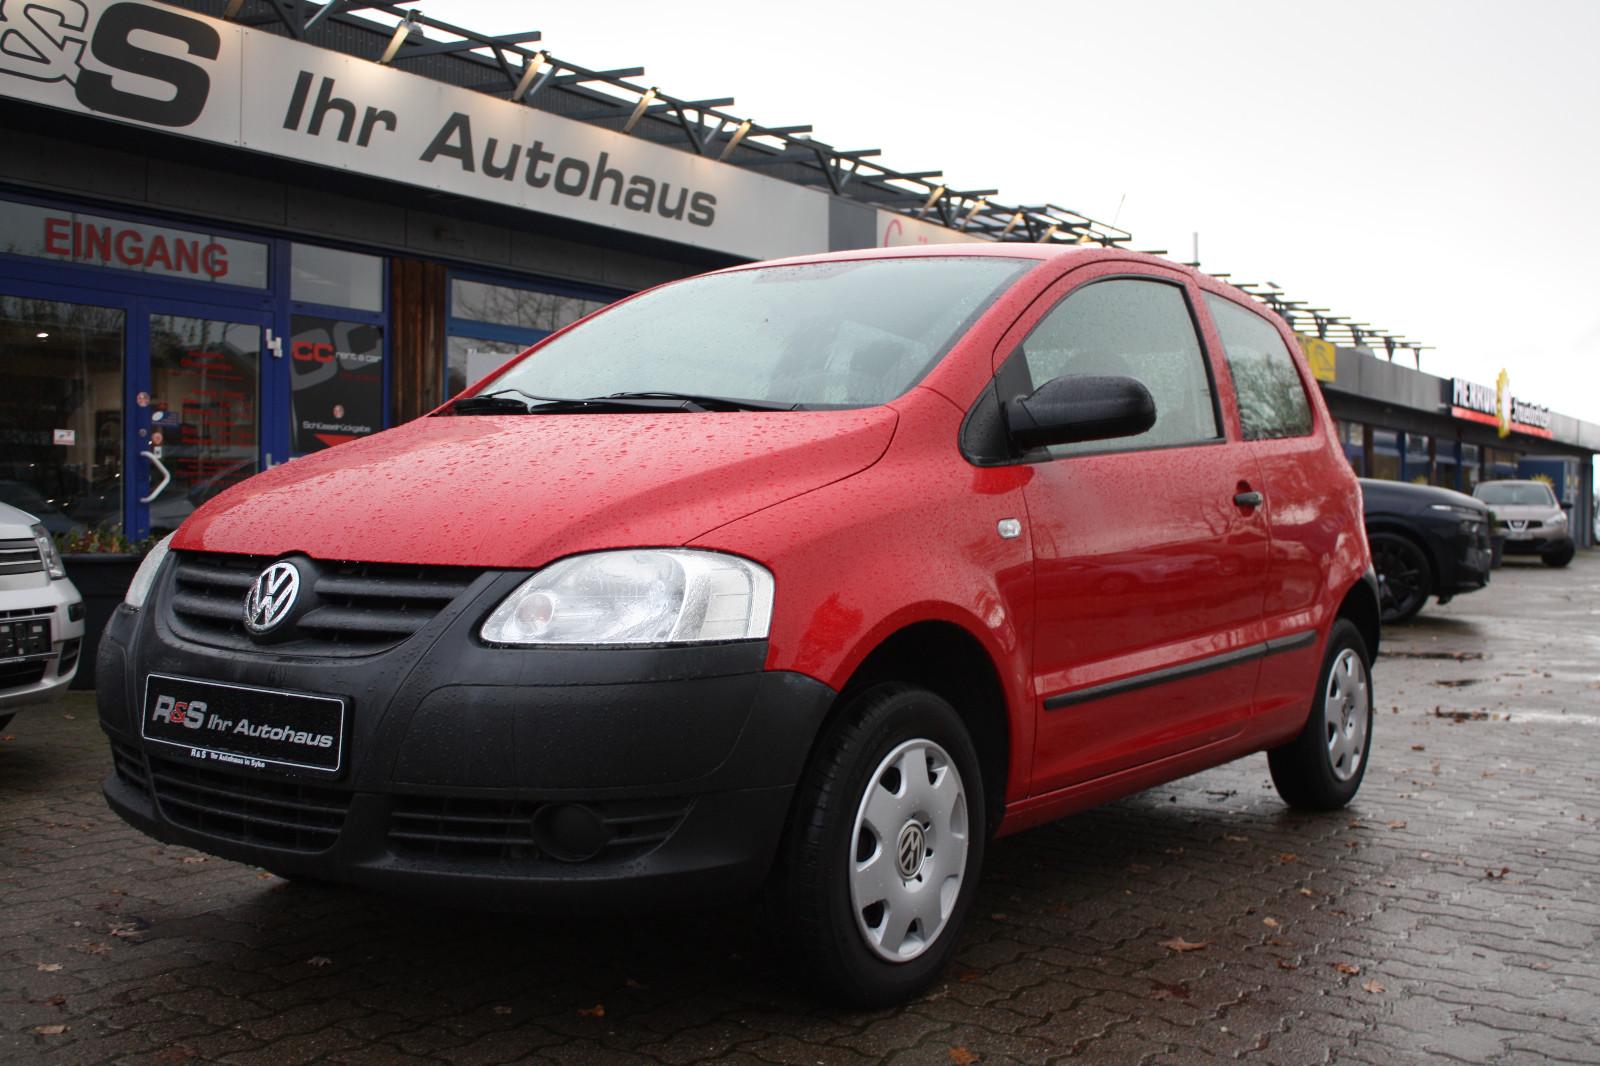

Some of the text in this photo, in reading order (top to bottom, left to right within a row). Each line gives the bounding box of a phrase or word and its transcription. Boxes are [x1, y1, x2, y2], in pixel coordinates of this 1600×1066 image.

[282, 70, 398, 147] Ihr
[419, 111, 718, 228] Autohaus
[44, 217, 229, 278] EINGANG
[152, 694, 334, 748] R&S Ihr Autohaus
